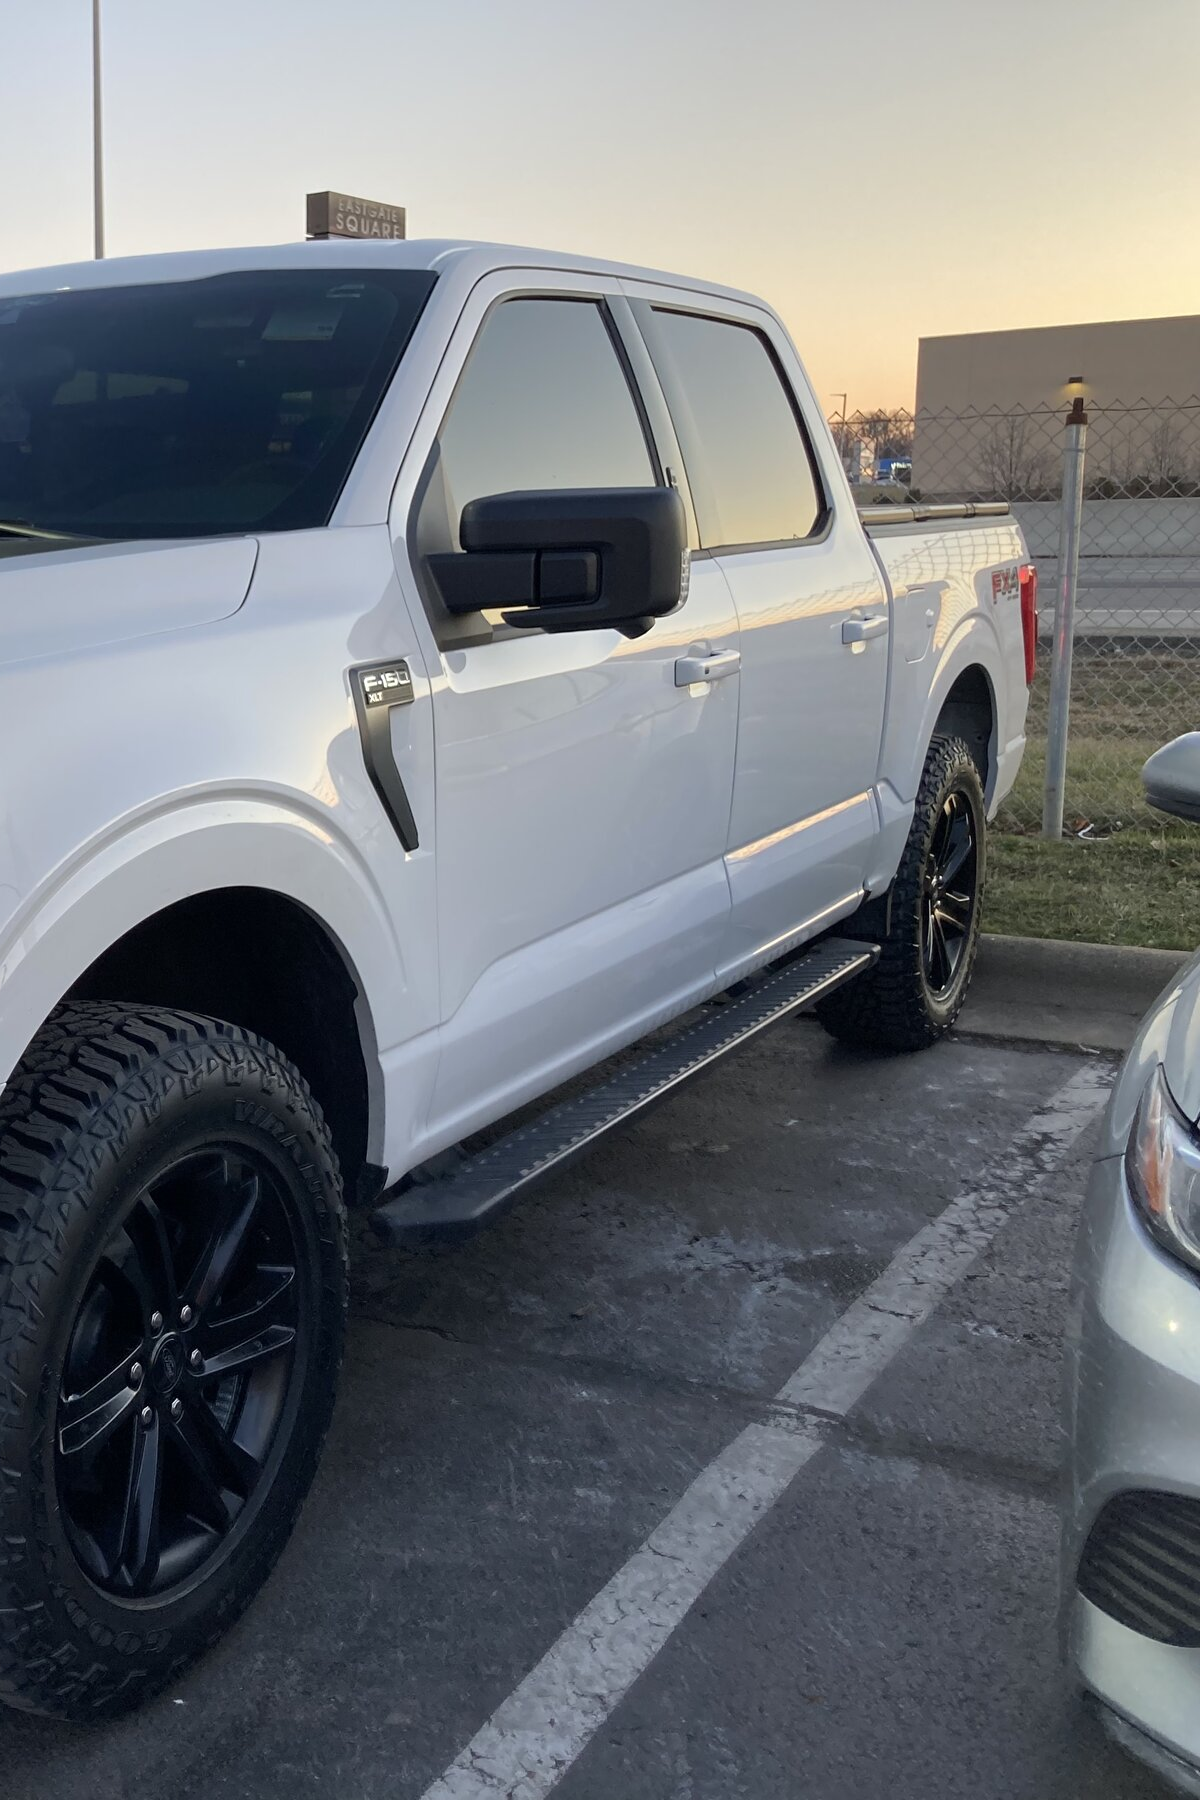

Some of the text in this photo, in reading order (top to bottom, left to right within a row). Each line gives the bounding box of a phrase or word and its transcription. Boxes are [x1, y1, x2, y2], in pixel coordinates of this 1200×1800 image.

[337, 198, 399, 223] EASTGATE
[335, 213, 401, 239] SQUARE
[991, 566, 1019, 605] FX4
[363, 670, 411, 692] F-150
[368, 692, 383, 703] XLT
